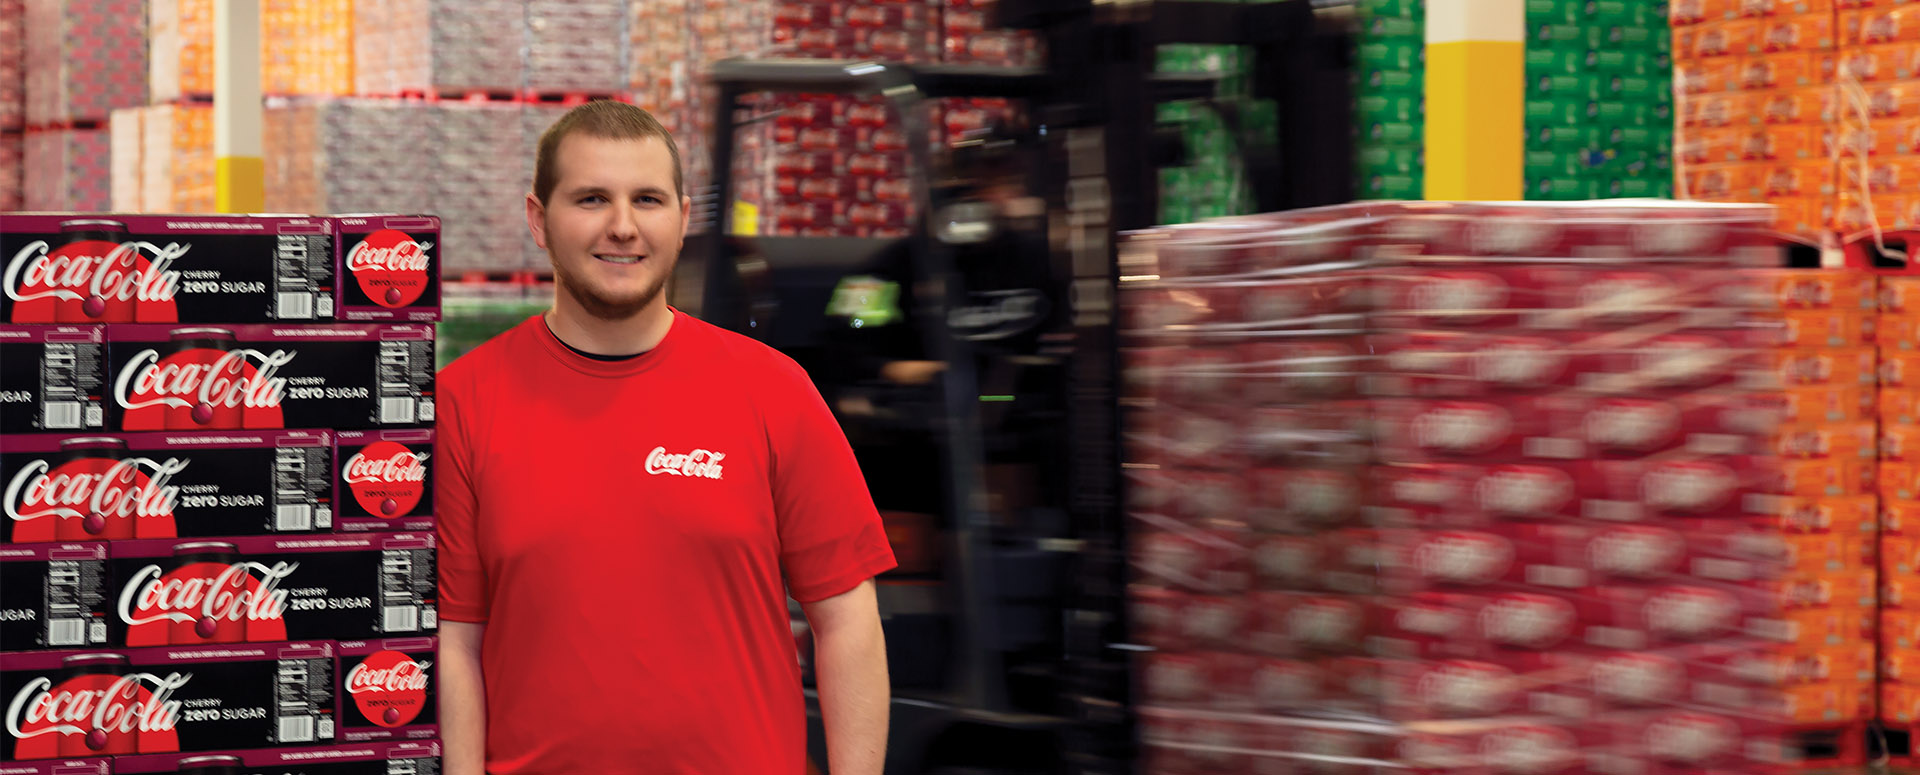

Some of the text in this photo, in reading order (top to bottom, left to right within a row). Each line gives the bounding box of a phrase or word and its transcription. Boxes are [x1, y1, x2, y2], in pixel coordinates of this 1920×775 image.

[345, 240, 434, 272] Coca-Cola
[3, 240, 194, 303] Coca-Cola
[183, 271, 221, 280] CHERRY
[183, 281, 266, 294] zero SUGAR
[115, 348, 300, 411] Coca-Cola
[288, 377, 326, 386] CHERRY
[288, 386, 369, 399] zero SUGAR
[342, 451, 431, 484] Coca-Cola
[645, 445, 726, 480] Coca-Cola
[4, 457, 192, 519] Coca-Cola
[182, 485, 220, 494] CHERRY
[182, 495, 265, 508] zero SUGAR
[118, 561, 302, 626] Coca-Cola
[290, 588, 329, 597] CHERRY
[291, 597, 372, 610] zero SUGAR
[346, 660, 433, 694] Coca-Cola
[6, 671, 194, 739] Coca-Cola
[184, 699, 222, 708] CHERRY
[184, 707, 267, 721] zero SUGAR
